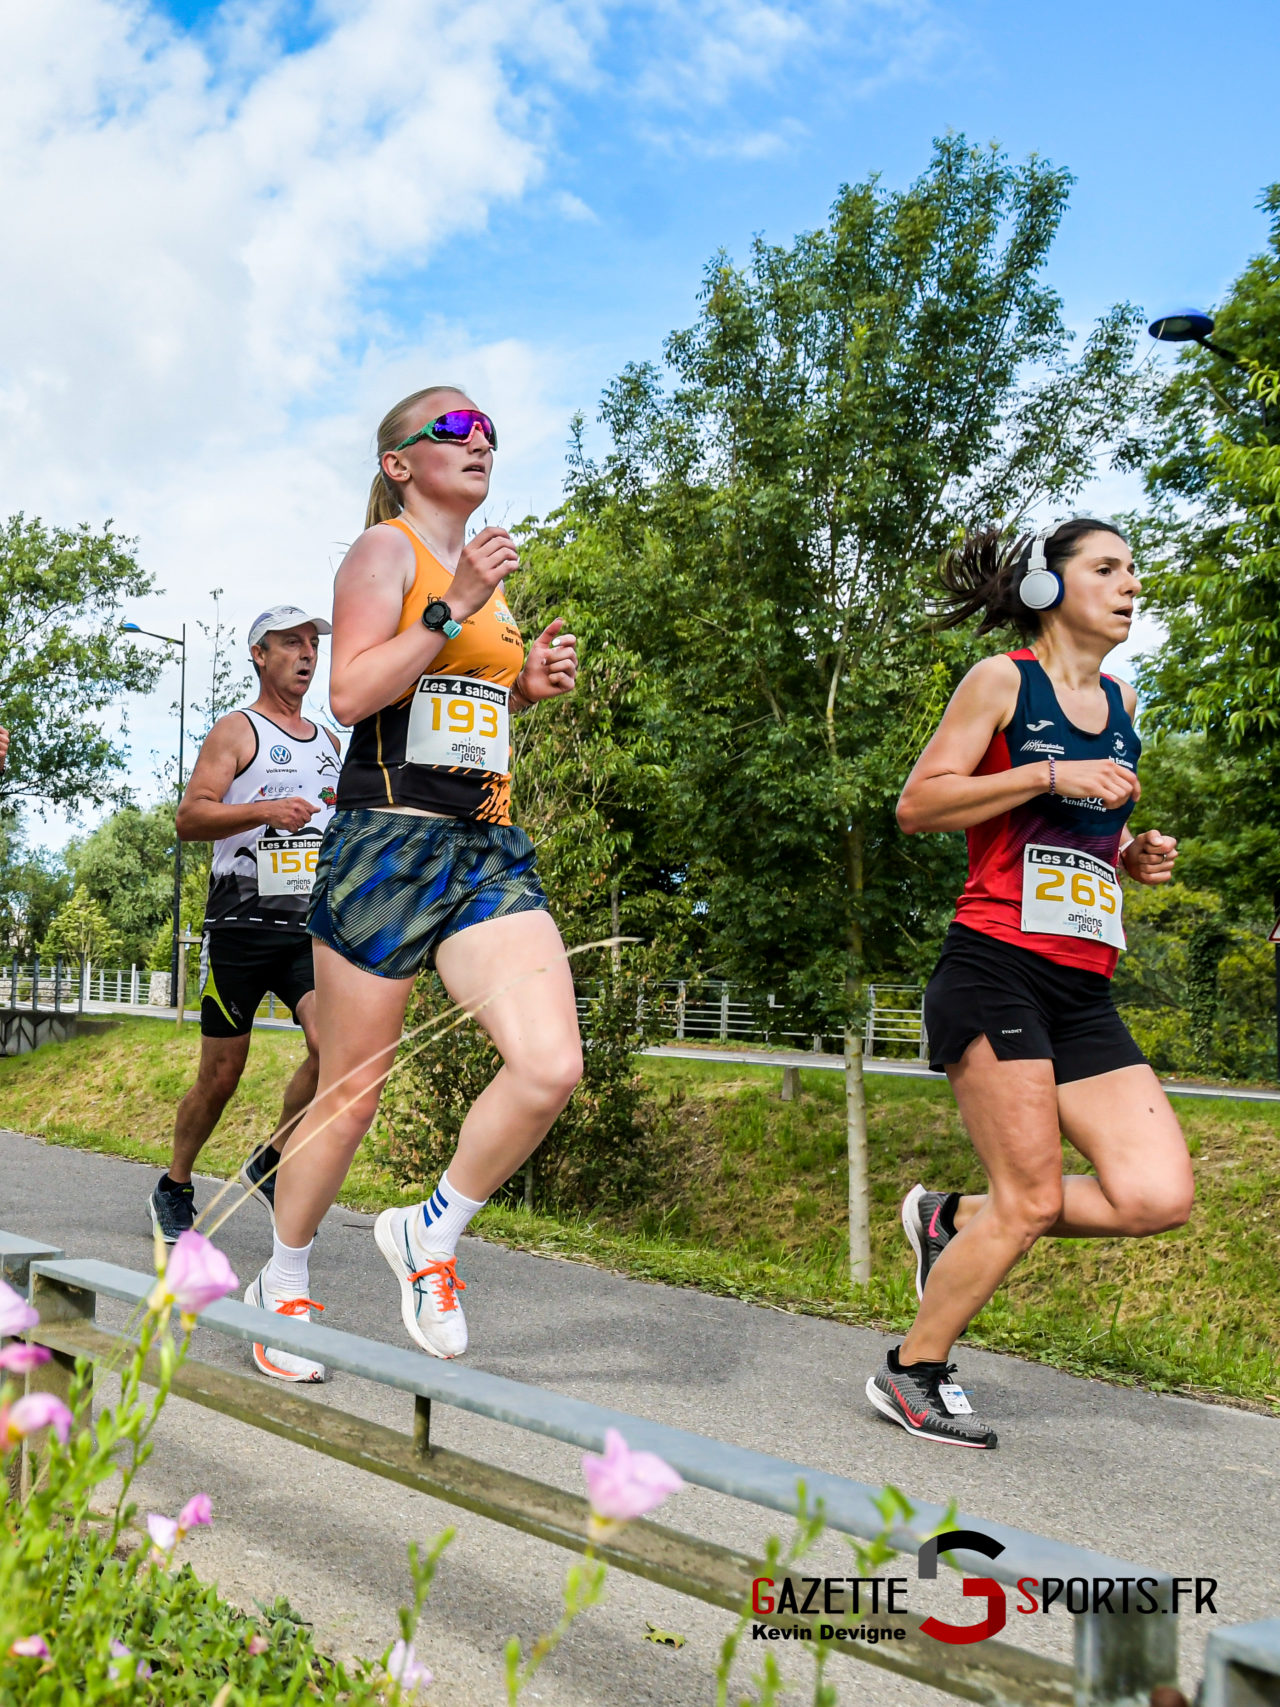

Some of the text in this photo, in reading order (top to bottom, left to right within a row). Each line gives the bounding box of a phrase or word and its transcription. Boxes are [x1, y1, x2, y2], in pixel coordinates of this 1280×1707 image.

[422, 679, 504, 704] Les 4 saisons
[431, 697, 498, 739] 193
[451, 743, 486, 756] amiens
[260, 839, 323, 850] Les 4 saison
[1031, 849, 1113, 882] Les 4 saisons
[1035, 867, 1116, 915] 265
[1067, 913, 1103, 928] amiens
